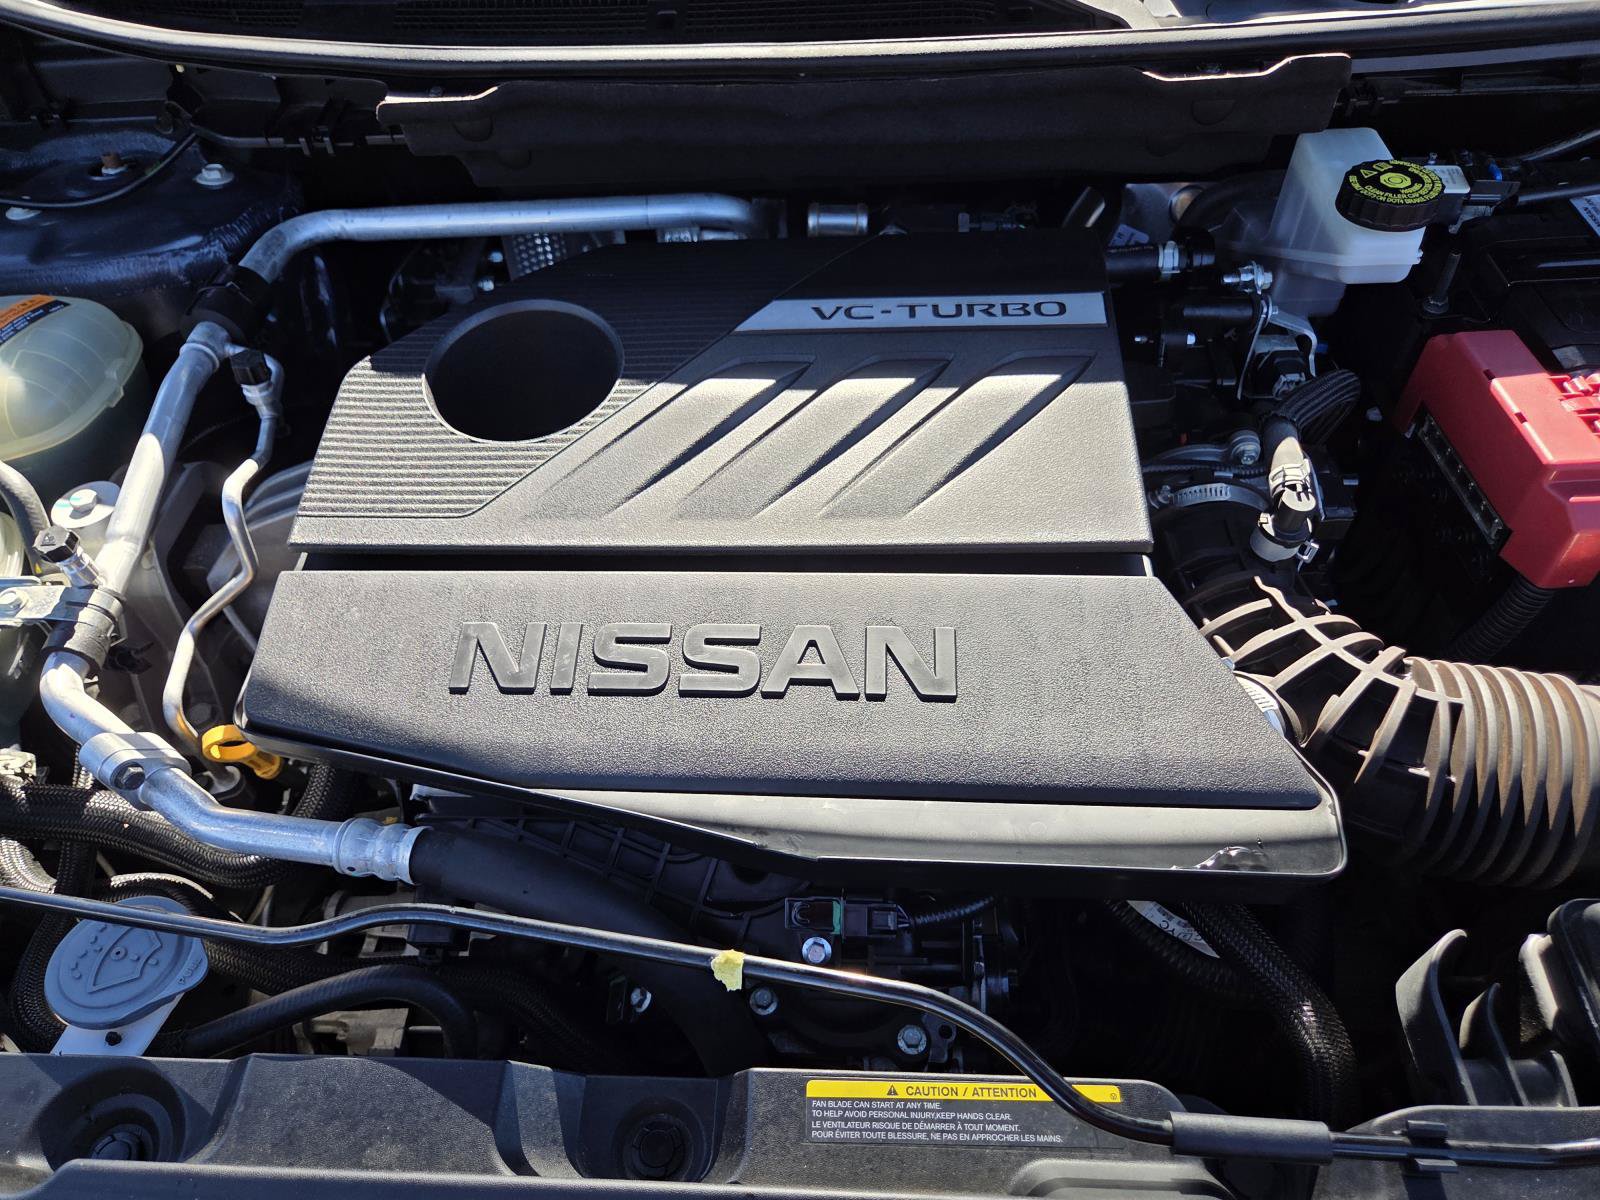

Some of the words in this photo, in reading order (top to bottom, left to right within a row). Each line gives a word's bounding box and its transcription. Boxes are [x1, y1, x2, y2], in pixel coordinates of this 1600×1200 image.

[811, 300, 1067, 321] VC-TURBO
[449, 621, 957, 702] NISSAN
[905, 1085, 959, 1097] CAUTION
[972, 1087, 1037, 1098] ATTENTION
[811, 1100, 827, 1108] FAN
[827, 1100, 852, 1108] BLADE
[871, 1101, 895, 1109] START
[923, 1102, 942, 1110] TIME.
[811, 1110, 822, 1118] TO
[823, 1110, 844, 1118] HELP
[844, 1110, 867, 1118] AVOID
[868, 1111, 909, 1119] PERSONAL
[956, 1112, 984, 1120] HANDS
[985, 1112, 1012, 1121] CLEAR.
[811, 1121, 821, 1129] LE
[822, 1121, 871, 1129] VENTILATEUR
[872, 1122, 900, 1130] RISQUE
[901, 1122, 912, 1130] DE
[914, 1120, 956, 1131] DÉMARRER
[964, 1123, 984, 1131] TOUT
[985, 1124, 1021, 1132] MOMENT.
[811, 1130, 834, 1138] POUR
[835, 1129, 860, 1139] ÉVITER
[862, 1131, 886, 1139] TOUTE
[887, 1132, 930, 1141] BLESSURE,
[942, 1133, 958, 1141] PAS
[959, 1133, 970, 1141] EN
[972, 1133, 1019, 1142] APPROCHER
[1020, 1134, 1036, 1142] LES
[1037, 1134, 1063, 1143] MAINS.
